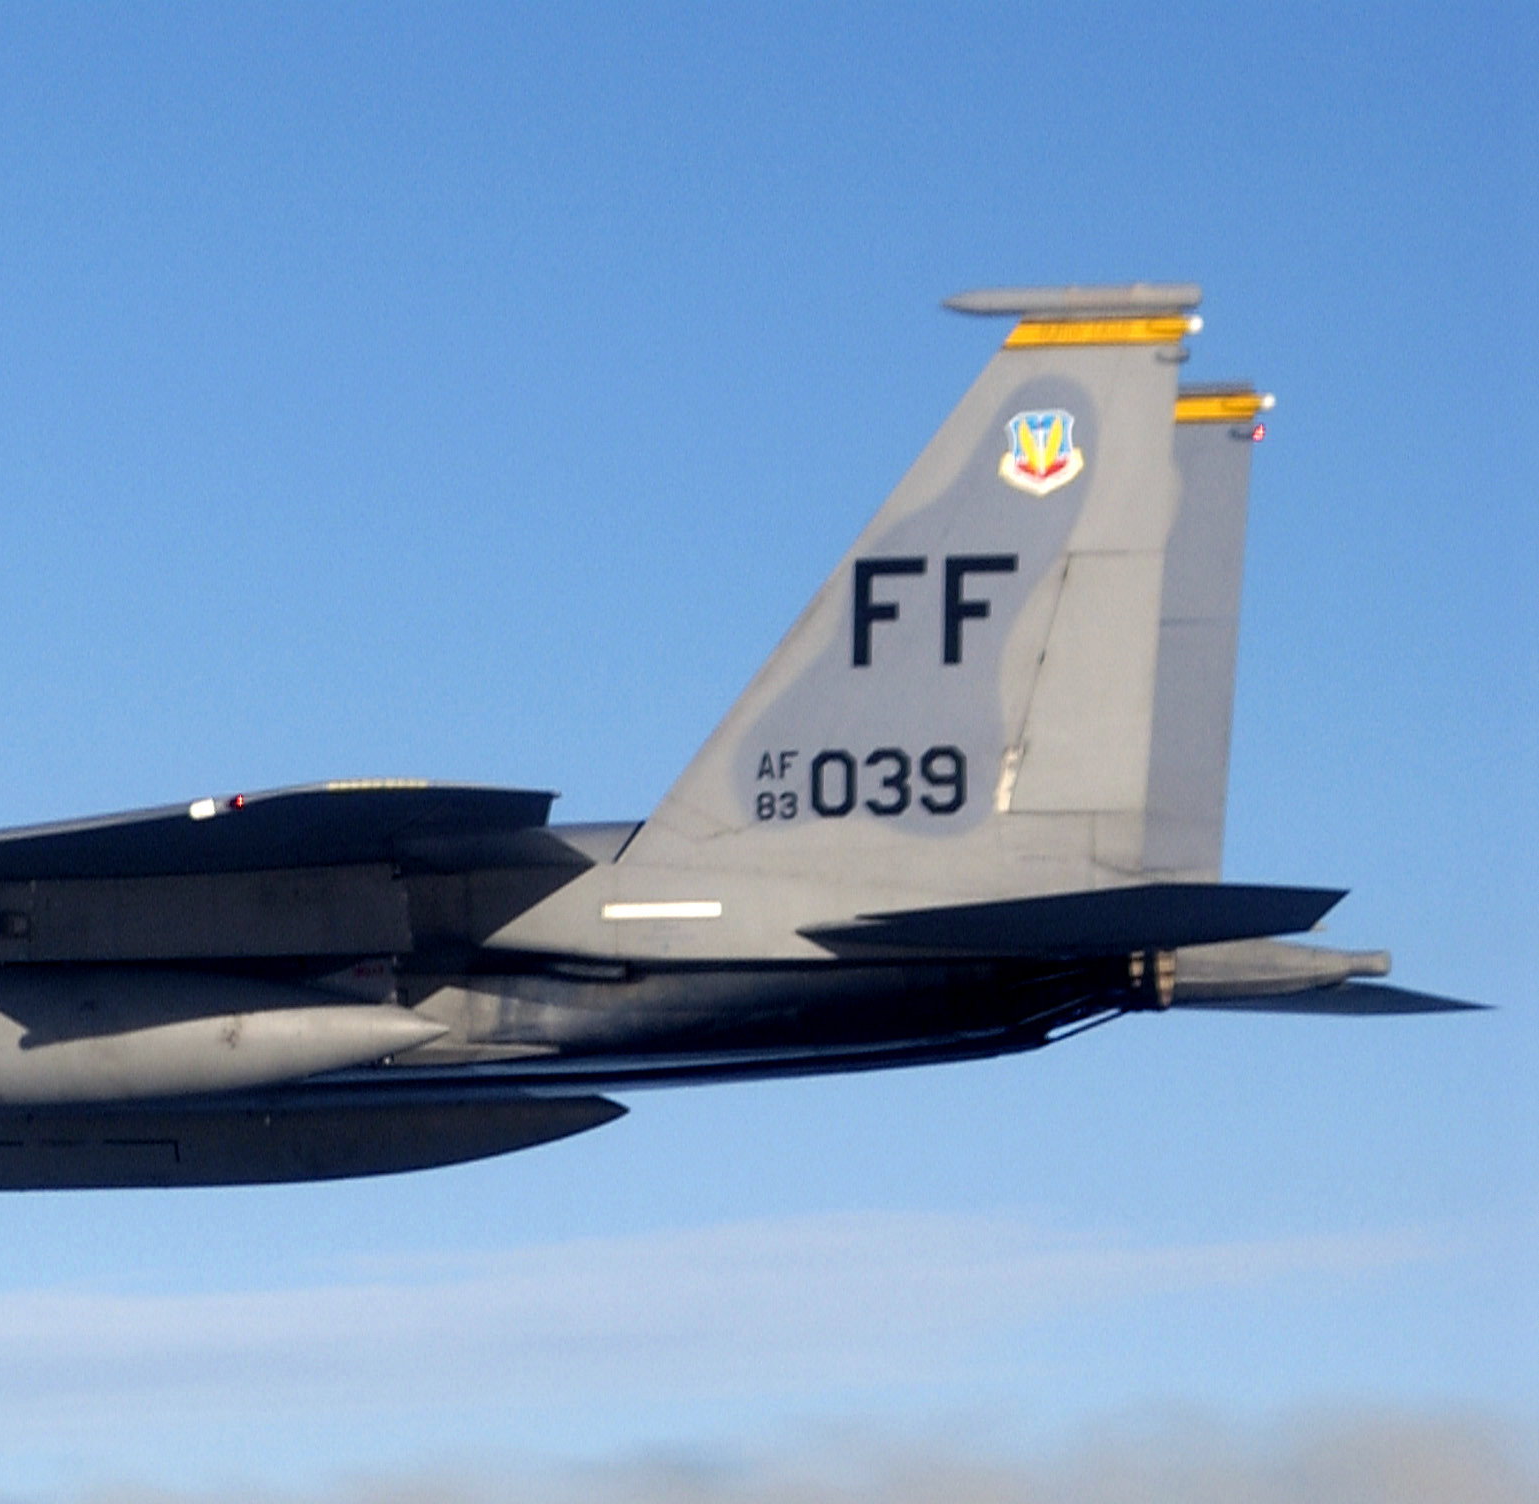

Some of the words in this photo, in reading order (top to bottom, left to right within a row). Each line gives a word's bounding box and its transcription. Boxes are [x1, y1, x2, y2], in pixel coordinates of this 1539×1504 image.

[853, 555, 1019, 668] FF
[756, 751, 799, 779] AF
[810, 746, 967, 817] 039
[756, 791, 798, 820] 83
